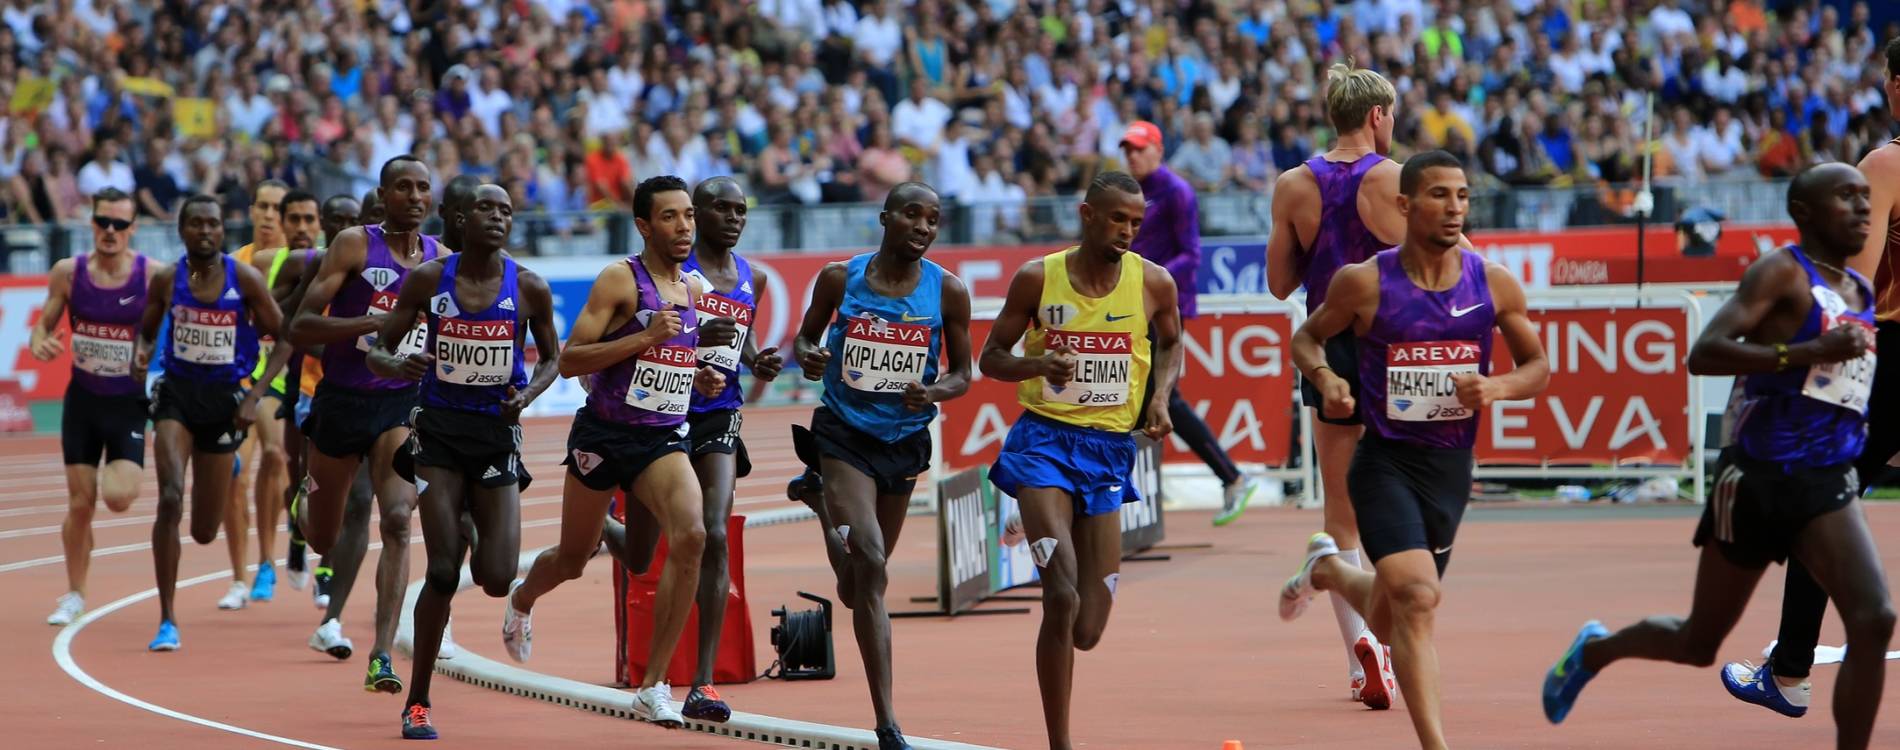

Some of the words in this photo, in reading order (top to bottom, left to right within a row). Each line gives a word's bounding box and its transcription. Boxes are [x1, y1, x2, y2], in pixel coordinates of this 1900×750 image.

[371, 270, 388, 286] 10
[437, 297, 448, 313] 6
[697, 295, 747, 321] AREVA
[200, 312, 232, 323] EVA
[1047, 305, 1063, 324] 11
[77, 323, 129, 339] AREVA
[443, 321, 509, 336] AREVA
[1047, 334, 1127, 349] AREVA
[438, 341, 511, 366] BIWOTT
[644, 346, 696, 363] AREVA
[714, 354, 733, 366] asics
[845, 344, 925, 373] KIPLAGAT
[1394, 346, 1475, 361] AREVA
[478, 374, 503, 383] asics
[1075, 359, 1128, 383] LEIMAN
[633, 366, 693, 395] IGUIDER
[886, 381, 908, 390] asic
[1390, 371, 1476, 397] MAKHLO
[1092, 393, 1119, 403] asics
[668, 403, 685, 412] asics
[577, 452, 590, 470] 12
